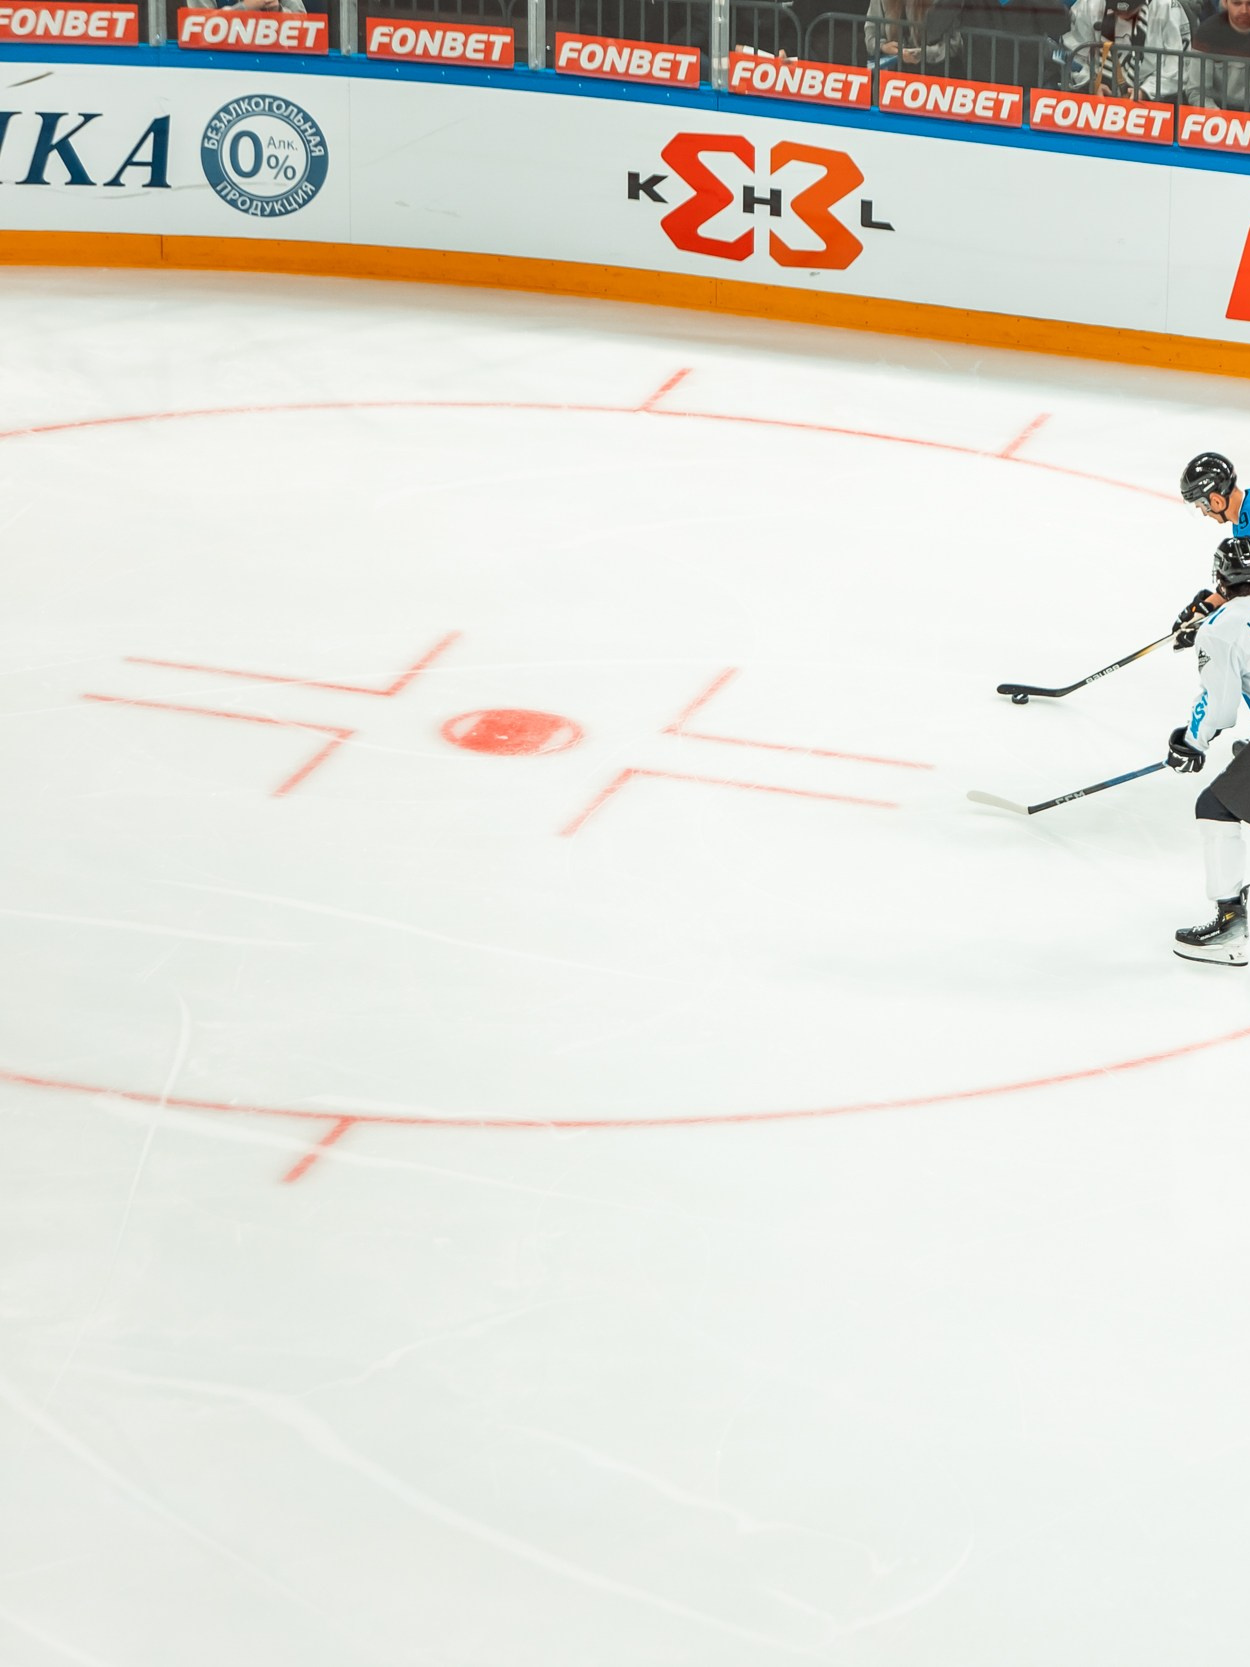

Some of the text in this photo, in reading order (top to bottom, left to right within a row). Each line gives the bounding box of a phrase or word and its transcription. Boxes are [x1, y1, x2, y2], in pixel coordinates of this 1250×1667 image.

[181, 15, 325, 48] FONBET
[369, 26, 511, 61] FONBET
[558, 41, 696, 81] FONBET
[731, 61, 868, 101] FONBET
[882, 79, 1020, 120] FONBET
[1032, 97, 1171, 137] FONBET
[204, 97, 325, 157] БЕЗАЛКОГОЛЬНАЯ
[267, 135, 298, 151] Алк.
[216, 180, 316, 216] ПРОДУКЦИЯ
